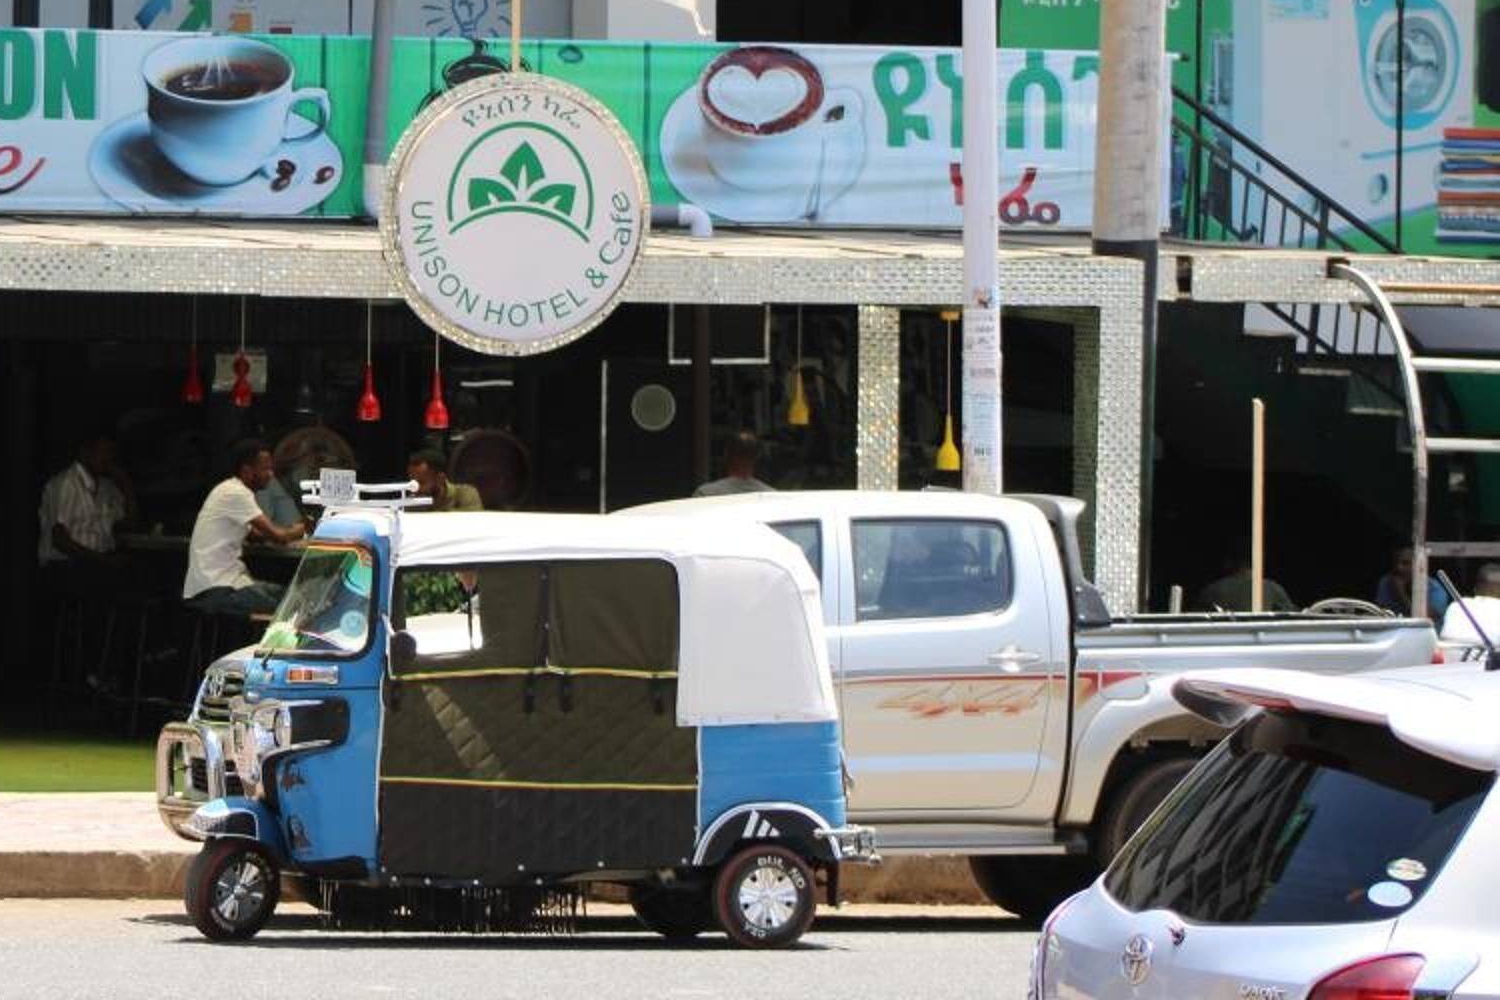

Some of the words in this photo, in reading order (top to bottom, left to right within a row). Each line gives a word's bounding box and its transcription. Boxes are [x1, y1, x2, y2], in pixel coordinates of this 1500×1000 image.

[410, 200, 480, 314] UNISON
[483, 288, 589, 328] HOTEL
[584, 266, 610, 290] &
[598, 190, 633, 266] Cafe
